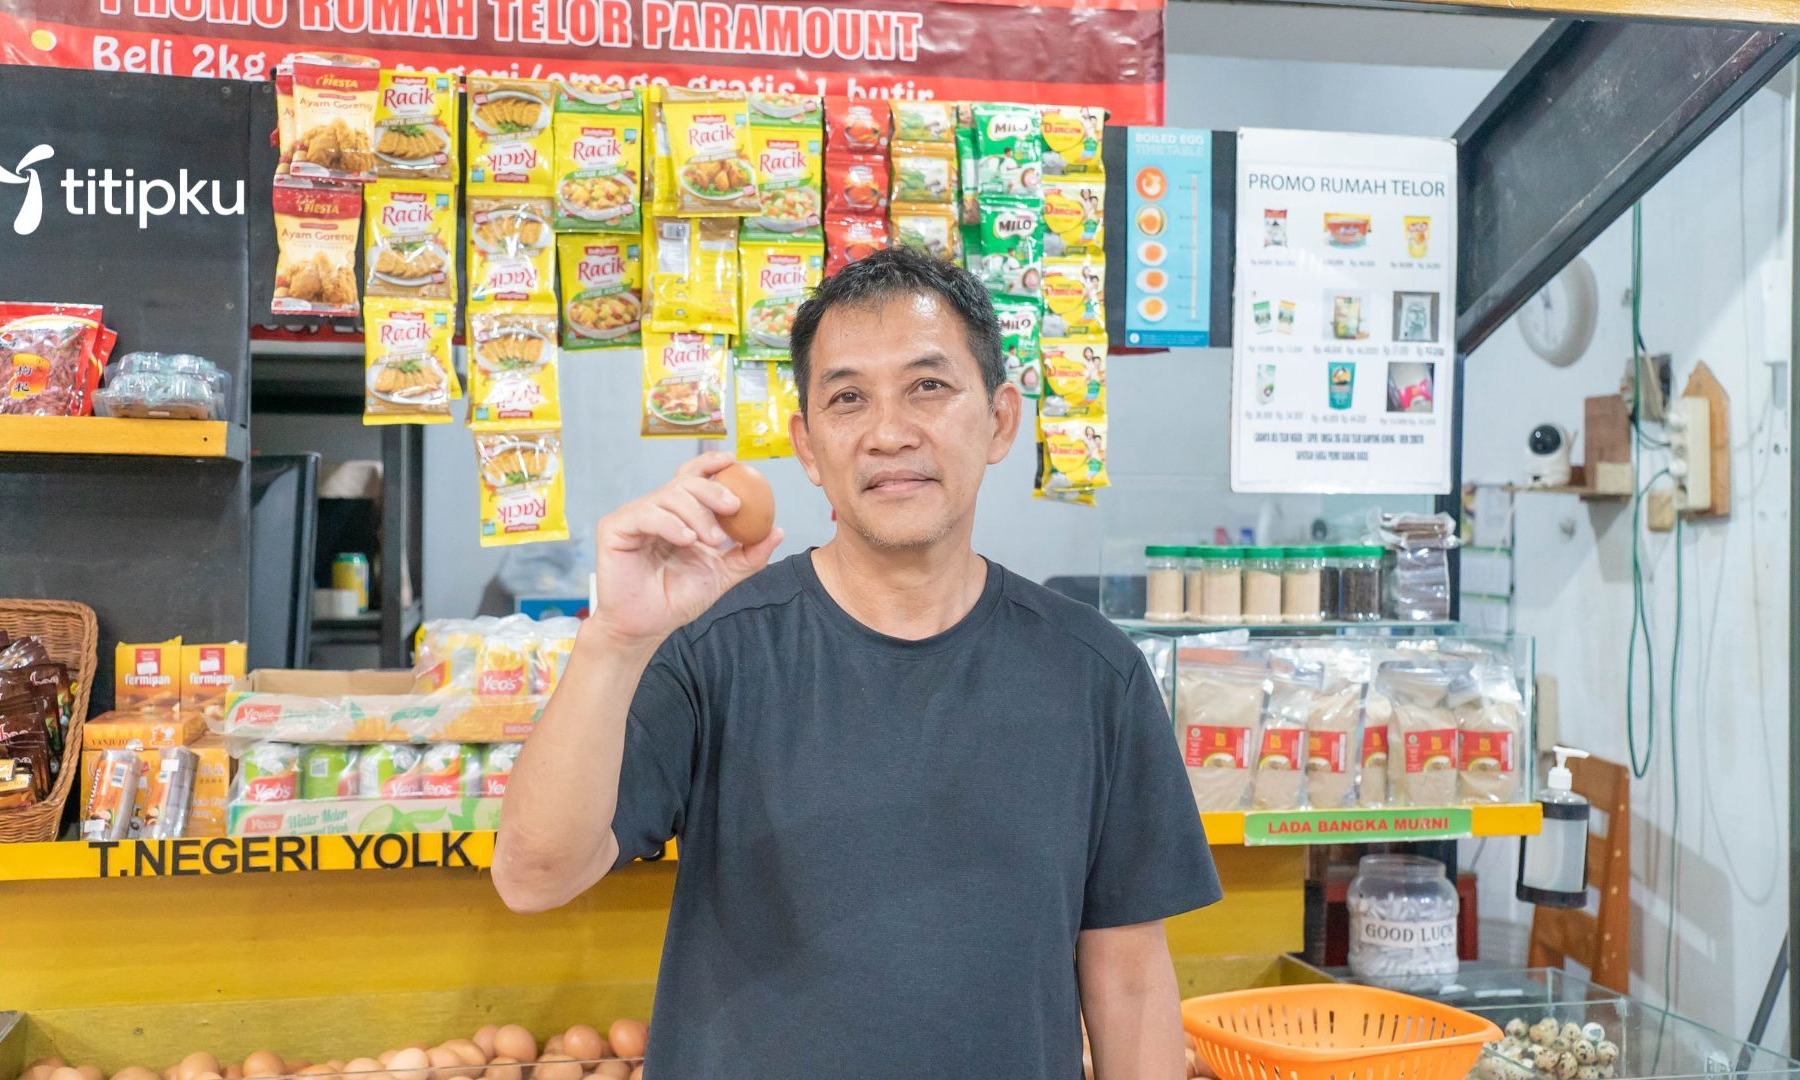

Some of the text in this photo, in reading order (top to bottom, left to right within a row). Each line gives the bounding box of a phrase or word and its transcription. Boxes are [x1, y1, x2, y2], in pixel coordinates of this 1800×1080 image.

[300, 0, 477, 40] RUMAH
[488, 0, 632, 48] TELOR
[643, 0, 921, 62] PARAMOUNT
[93, 35, 173, 76] Beli
[192, 44, 266, 82] 2kg
[383, 87, 434, 107] Racik
[688, 124, 736, 146] Racik
[1135, 132, 1176, 144] BOILED
[487, 148, 538, 170] Racik
[573, 139, 622, 160] Racik
[759, 151, 806, 173] Racik
[1249, 173, 1446, 197] PROMO RUMAH TELOR
[381, 204, 434, 226] Racik
[999, 219, 1031, 231] MILO
[281, 228, 355, 242] Ayam Goreng
[578, 256, 627, 281] Racik
[759, 267, 808, 289] Racik
[380, 322, 433, 344] Racik
[1000, 318, 1031, 330] MILO
[662, 344, 712, 368] Racik
[497, 498, 547, 523] Racik
[124, 673, 171, 687] fermipan
[189, 672, 235, 686] fermipan
[482, 676, 518, 692] Yeo's
[1267, 817, 1449, 834] LADA BANGKA MURNI
[88, 831, 474, 878] T.NEGERI YOLK
[1365, 922, 1414, 942] GOOD
